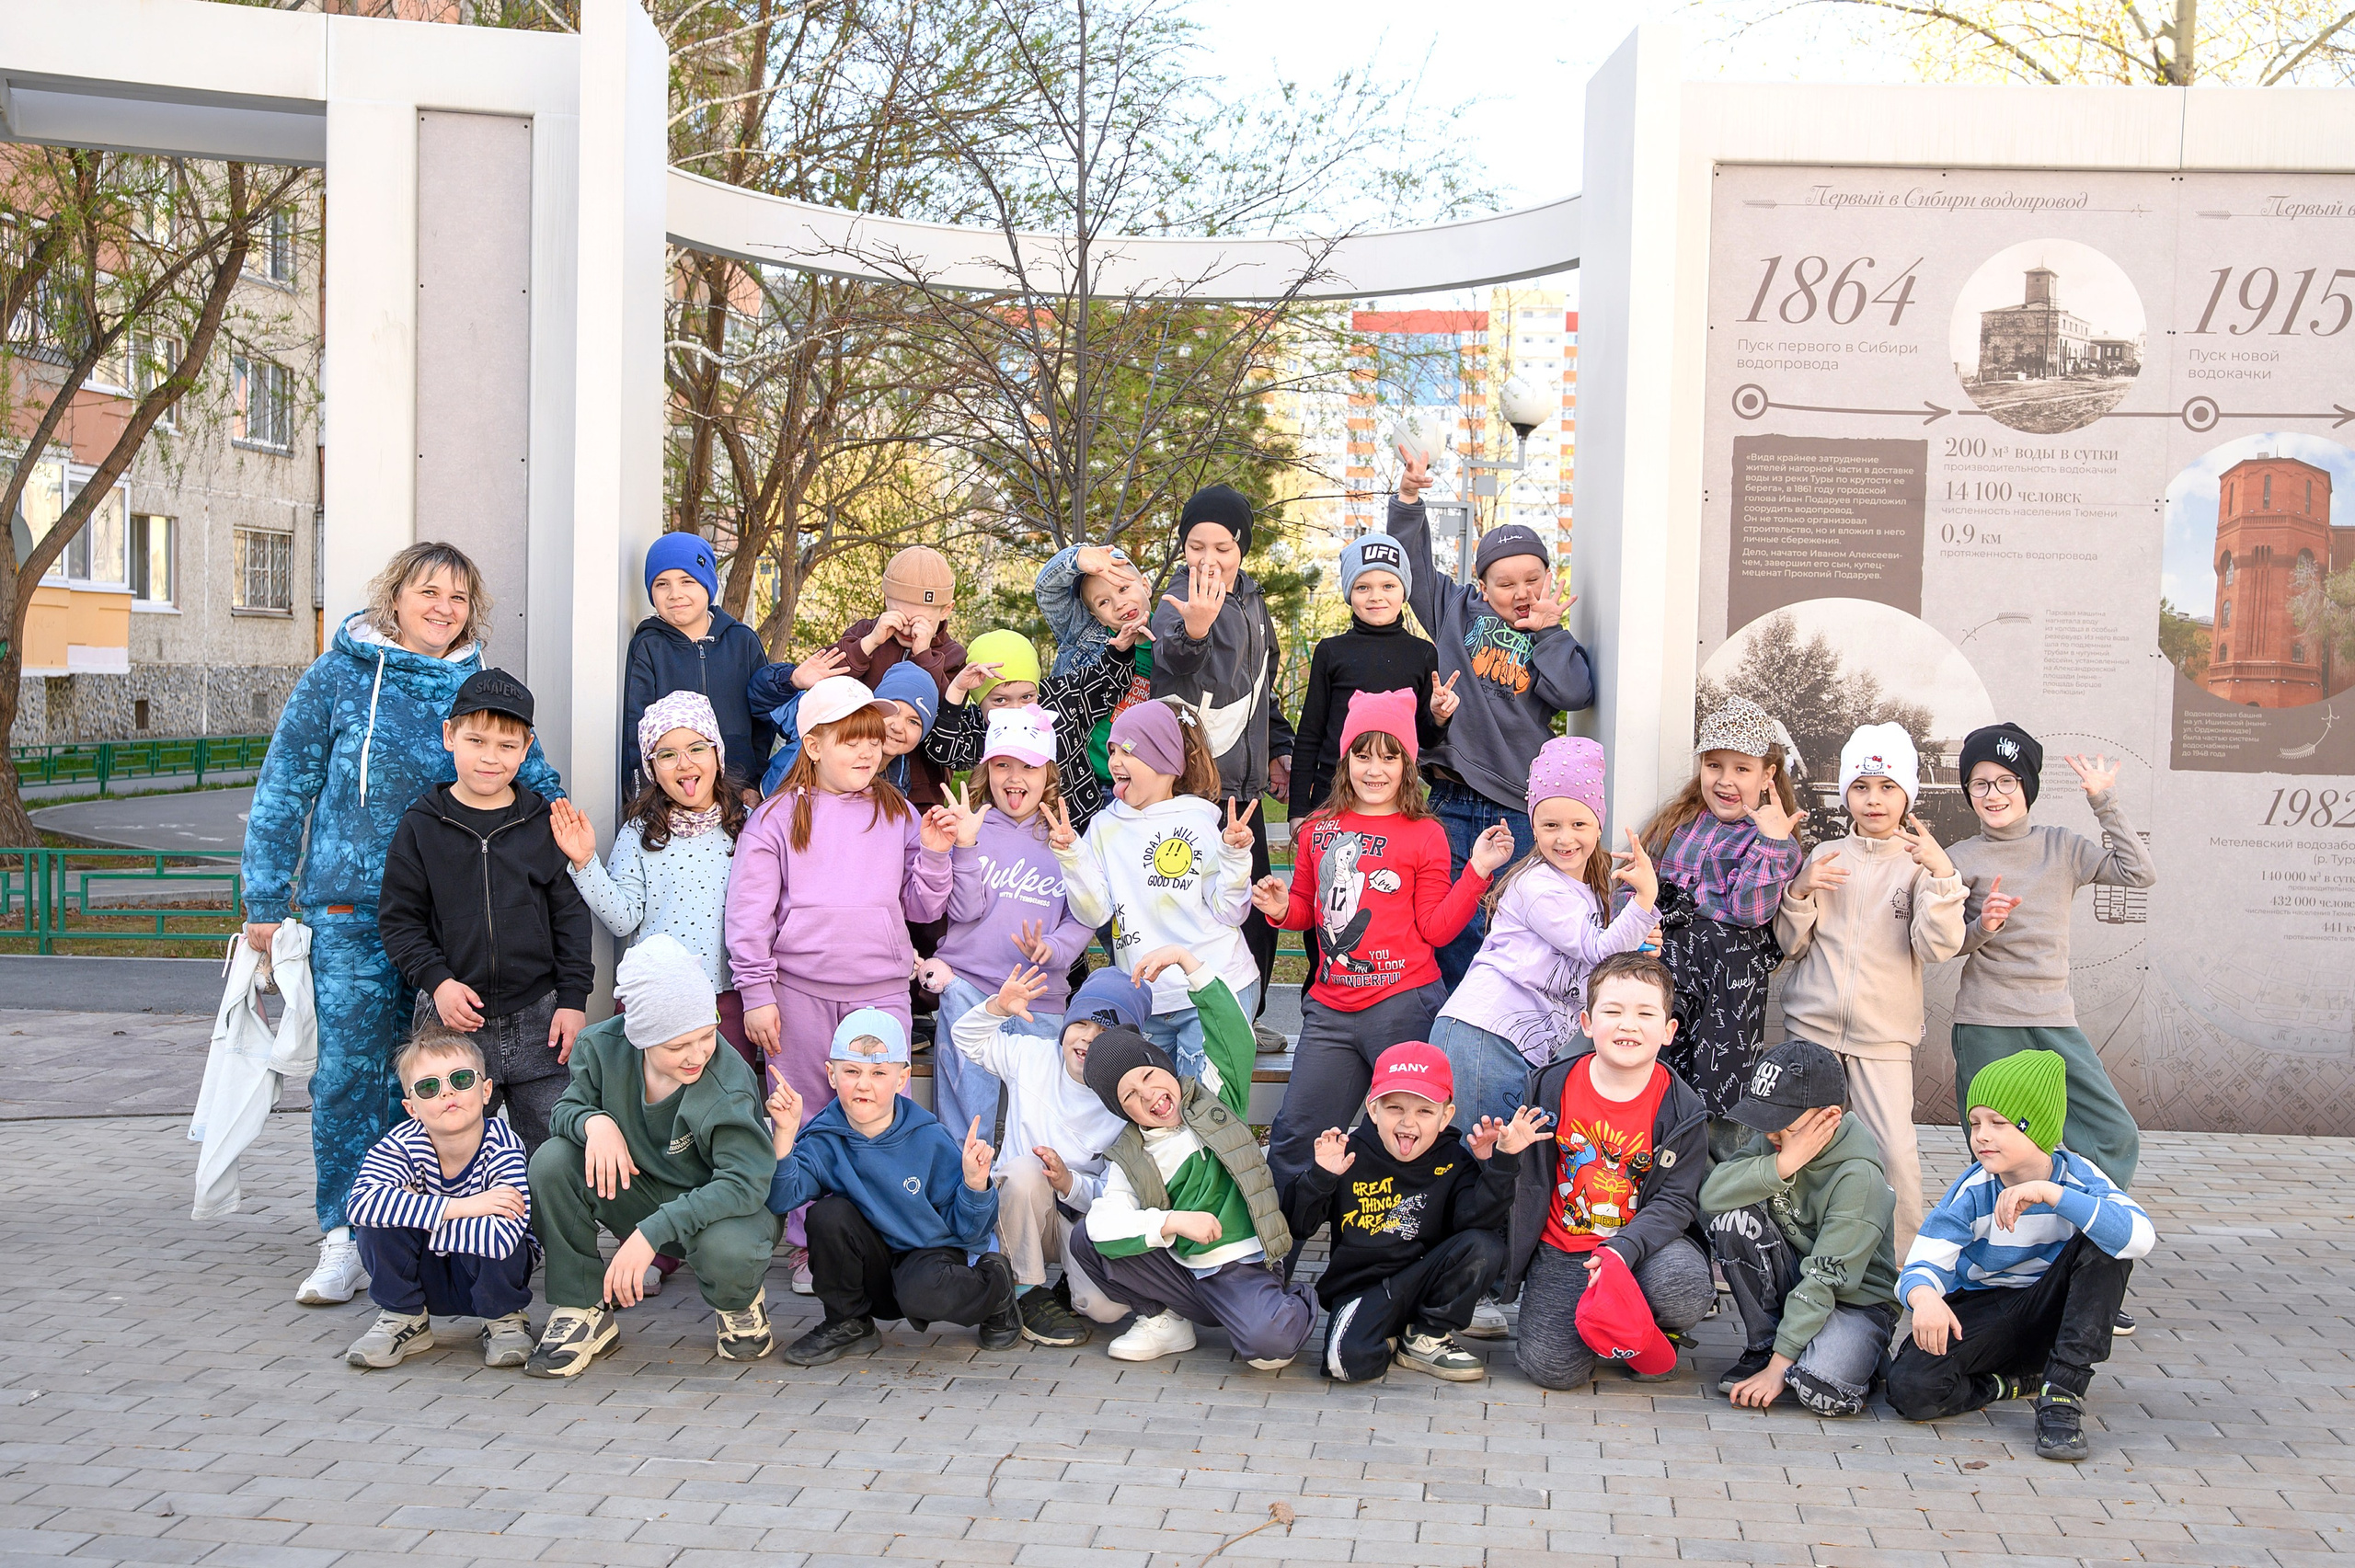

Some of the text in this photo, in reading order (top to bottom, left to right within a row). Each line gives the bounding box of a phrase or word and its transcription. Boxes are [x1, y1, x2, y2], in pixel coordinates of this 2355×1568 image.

[1805, 185, 2087, 214] Первый в Сибири водопровод
[2260, 194, 2343, 220] Первый
[1735, 255, 1924, 326] 1864
[2184, 266, 2355, 337] 1915
[1738, 339, 1918, 355] Пуск первого в Сибири
[2188, 349, 2280, 363] Пуск новой
[1737, 358, 1839, 372] водопровода
[2188, 367, 2271, 381] водокачки
[1945, 438, 1986, 457] 200
[2016, 449, 2054, 462] воды
[2061, 451, 2069, 460] в
[2074, 451, 2118, 464] сутки
[1777, 454, 1816, 464] крайнее
[1819, 455, 1878, 464] затруднение
[1746, 464, 1786, 473] жителей
[1789, 464, 1832, 475] нагорной
[1944, 463, 2117, 475] производительность водокачки
[1746, 475, 1769, 484] воды
[1786, 476, 1808, 485] реки
[1810, 475, 1833, 486] Туры
[1850, 477, 1891, 486] крутости
[1837, 486, 1886, 497] городской
[2018, 491, 2081, 503] человек
[1805, 496, 1850, 506] Подаруев
[1744, 506, 1792, 514] соорудить
[1942, 507, 2118, 518] численность населения Тюмени
[1807, 518, 1867, 526] организовал
[1941, 523, 2001, 546] 0,9 км
[1364, 545, 1398, 563] UFC
[1810, 550, 1846, 558] Иваном
[2026, 552, 2097, 561] водопровода
[1764, 560, 1810, 568] завершил
[1785, 570, 1832, 579] Прокопий
[476, 679, 523, 701] SKATERS
[2257, 788, 2355, 827] 1982
[1315, 819, 1340, 830] GIRL
[1143, 831, 1161, 869] TODAY
[1173, 827, 1199, 846] WILL
[1312, 831, 1387, 857] POER
[2210, 837, 2292, 848] Метелевский
[978, 855, 1067, 899] Vulpes
[1148, 876, 1193, 890] GOOD DAY
[1331, 887, 1346, 911] 17
[1369, 950, 1389, 960] YOU
[1378, 959, 1406, 971] LOOK
[1389, 1063, 1429, 1073] SANY
[1353, 1177, 1394, 1196] GREAT
[1357, 1213, 1384, 1230] ARE
